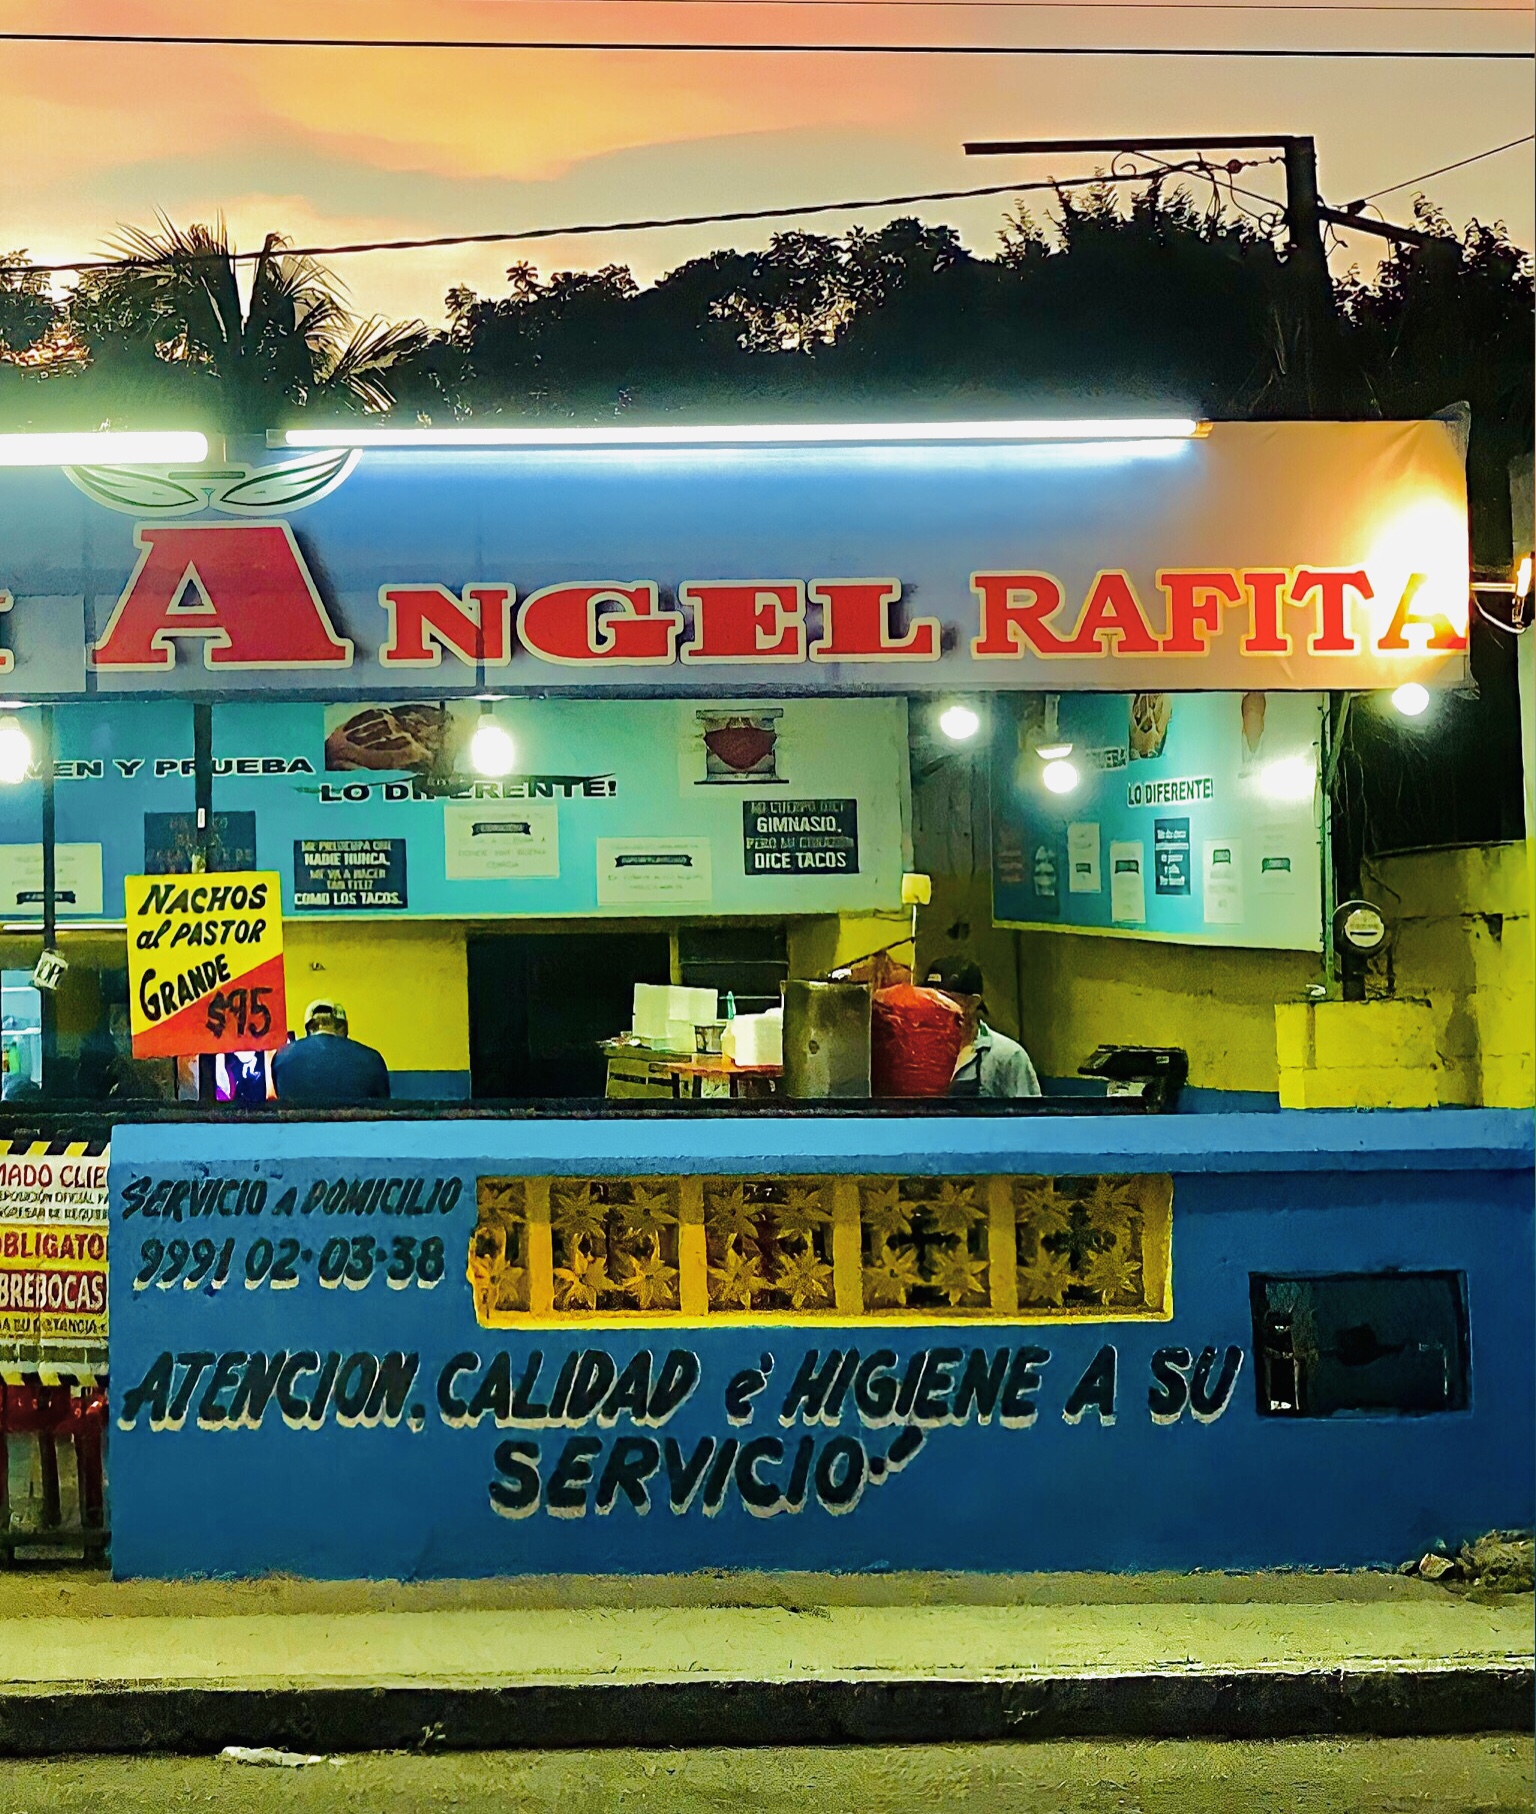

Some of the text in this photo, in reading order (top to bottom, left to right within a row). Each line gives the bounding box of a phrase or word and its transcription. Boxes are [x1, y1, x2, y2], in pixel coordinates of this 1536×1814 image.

[85, 519, 941, 671] ANGEL
[970, 563, 1467, 659] RAFITA
[113, 758, 146, 778] Y
[154, 757, 317, 779] PRUEBA
[320, 778, 617, 803] LO DIRENTE!
[1127, 782, 1142, 806] LO
[755, 852, 847, 869] DICE TACOS
[137, 883, 268, 915] NACHOS
[294, 893, 330, 905] COMO
[333, 892, 357, 905] LOS
[136, 918, 267, 950] al PASTOR
[139, 953, 231, 1021] GRANDE
[205, 986, 273, 1039] $95
[121, 1175, 268, 1222] SERVICIO
[300, 1175, 463, 1217] DOMICILIO
[132, 1236, 235, 1291] 9991
[435, 1348, 701, 1430] CALIDAD
[777, 1345, 1052, 1430] HIGIENE
[1063, 1342, 1120, 1427] A
[1148, 1343, 1247, 1427] SU
